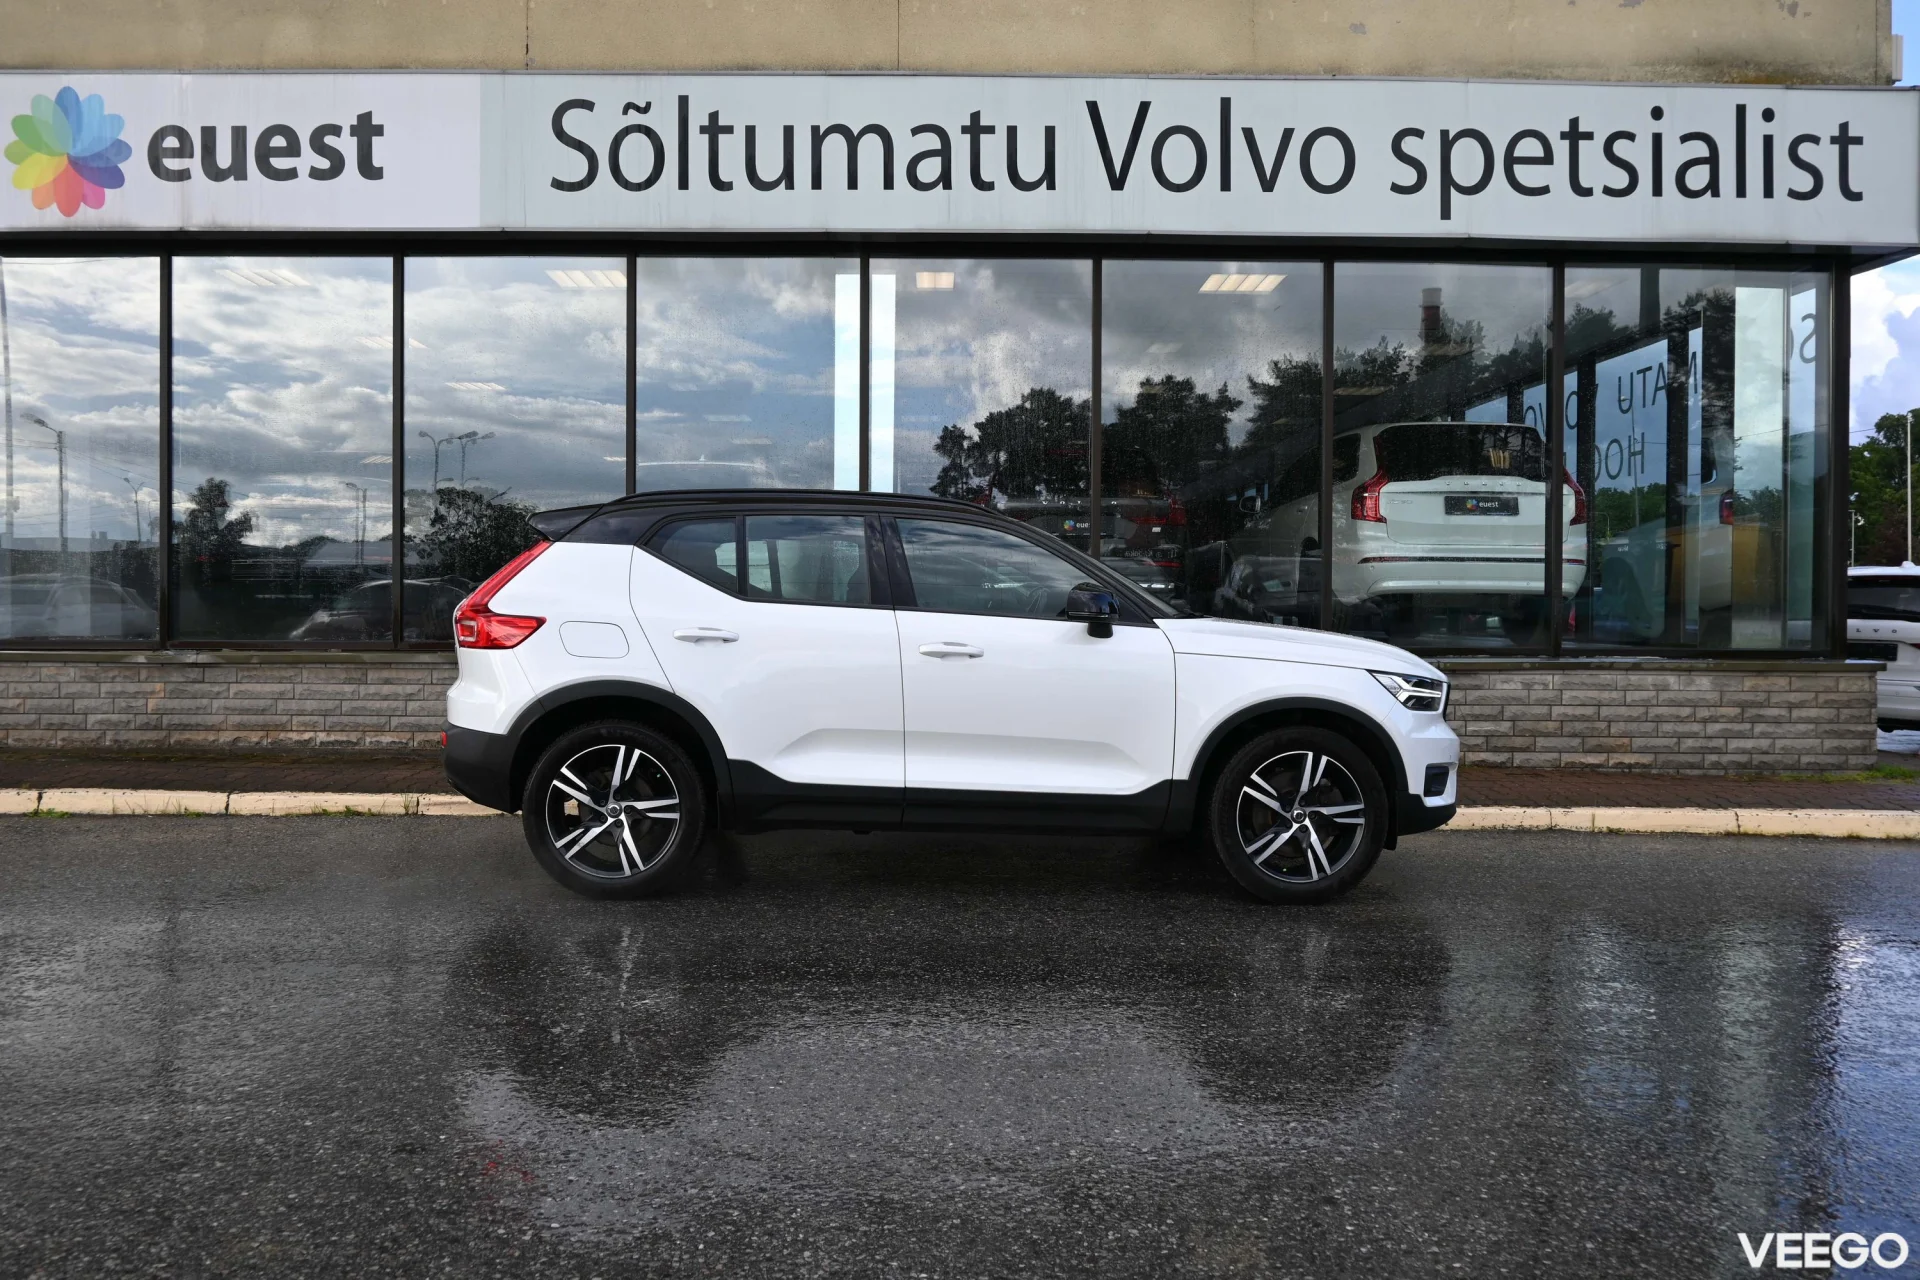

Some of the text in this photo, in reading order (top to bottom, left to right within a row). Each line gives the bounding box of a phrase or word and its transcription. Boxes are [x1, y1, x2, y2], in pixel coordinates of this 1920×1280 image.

[147, 110, 385, 183] euest
[550, 94, 1865, 222] Sõltumatu Volvo spetsialist
[1479, 500, 1499, 508] euest
